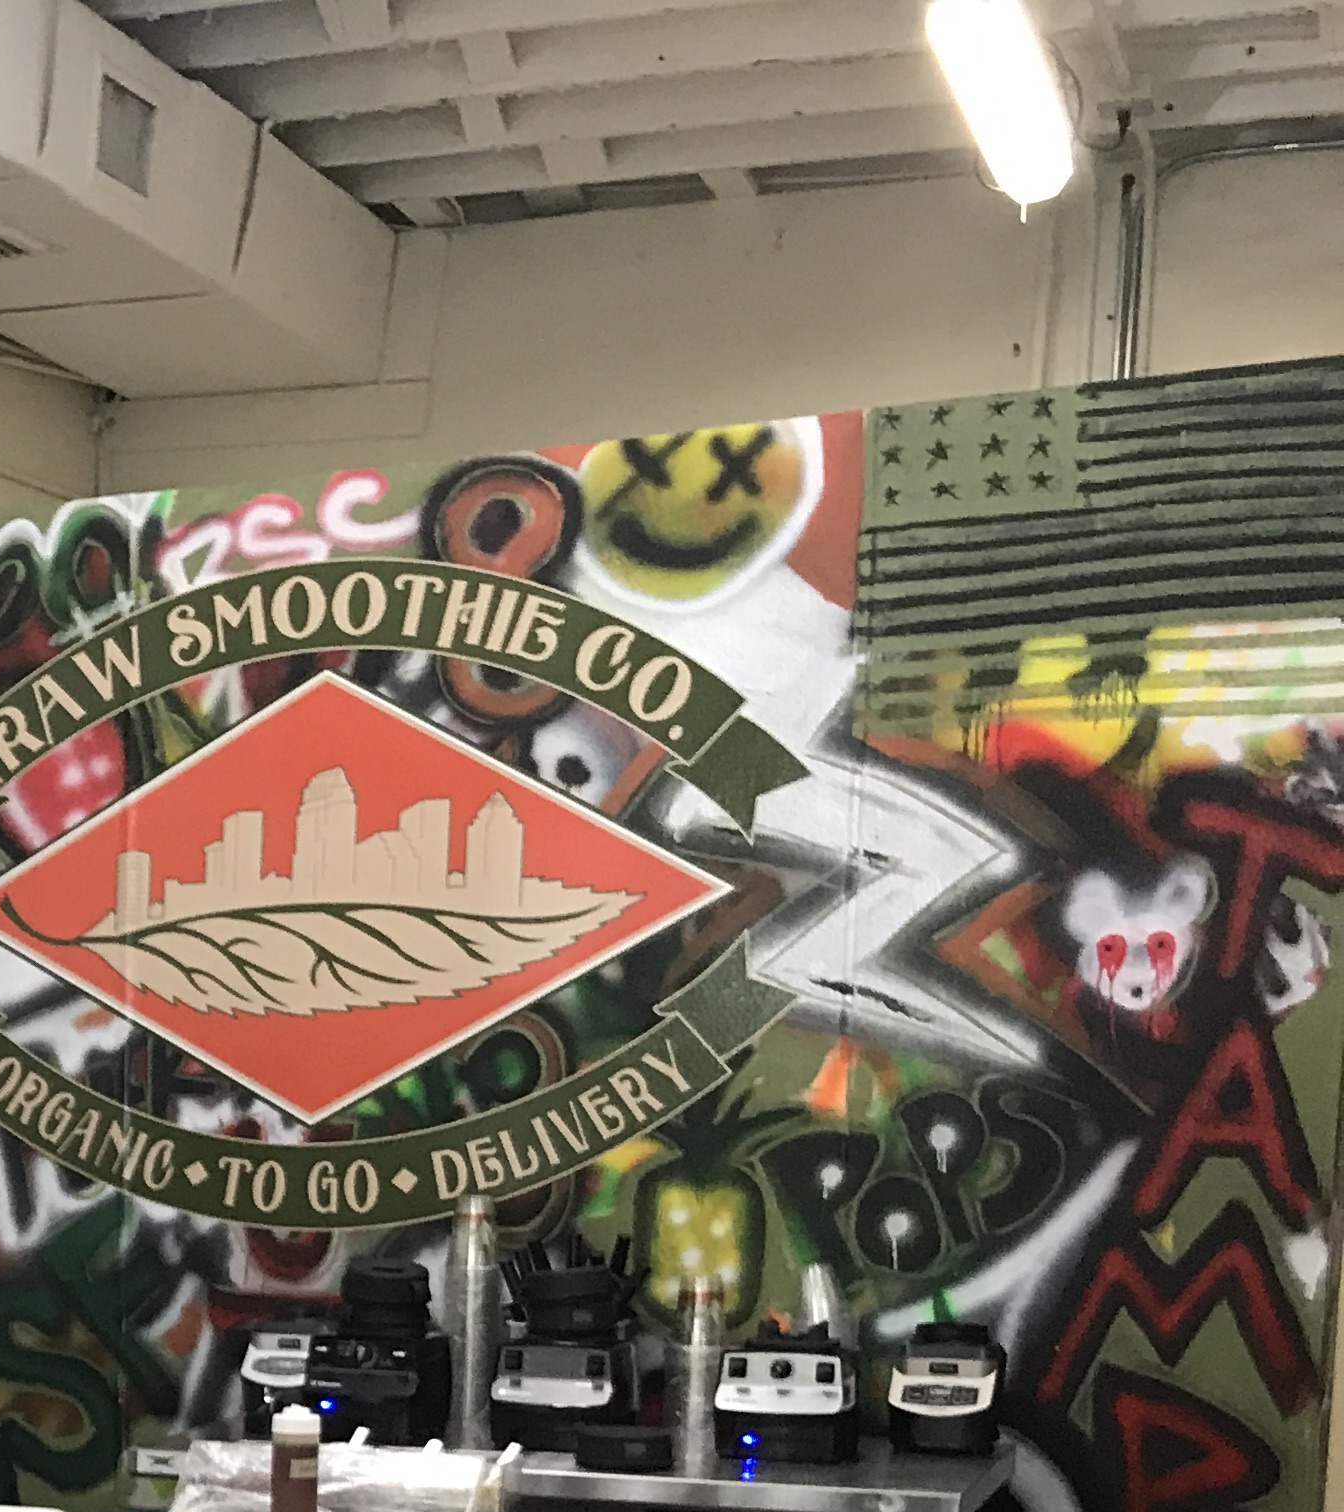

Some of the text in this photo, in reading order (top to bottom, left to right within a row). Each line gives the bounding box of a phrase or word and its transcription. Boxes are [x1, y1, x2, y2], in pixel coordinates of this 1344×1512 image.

[166, 571, 567, 668] SMOOTHIE
[575, 624, 693, 742] CO.
[218, 1156, 287, 1214] TO
[307, 1158, 380, 1215] GO
[430, 1038, 692, 1201] DELIVERY
